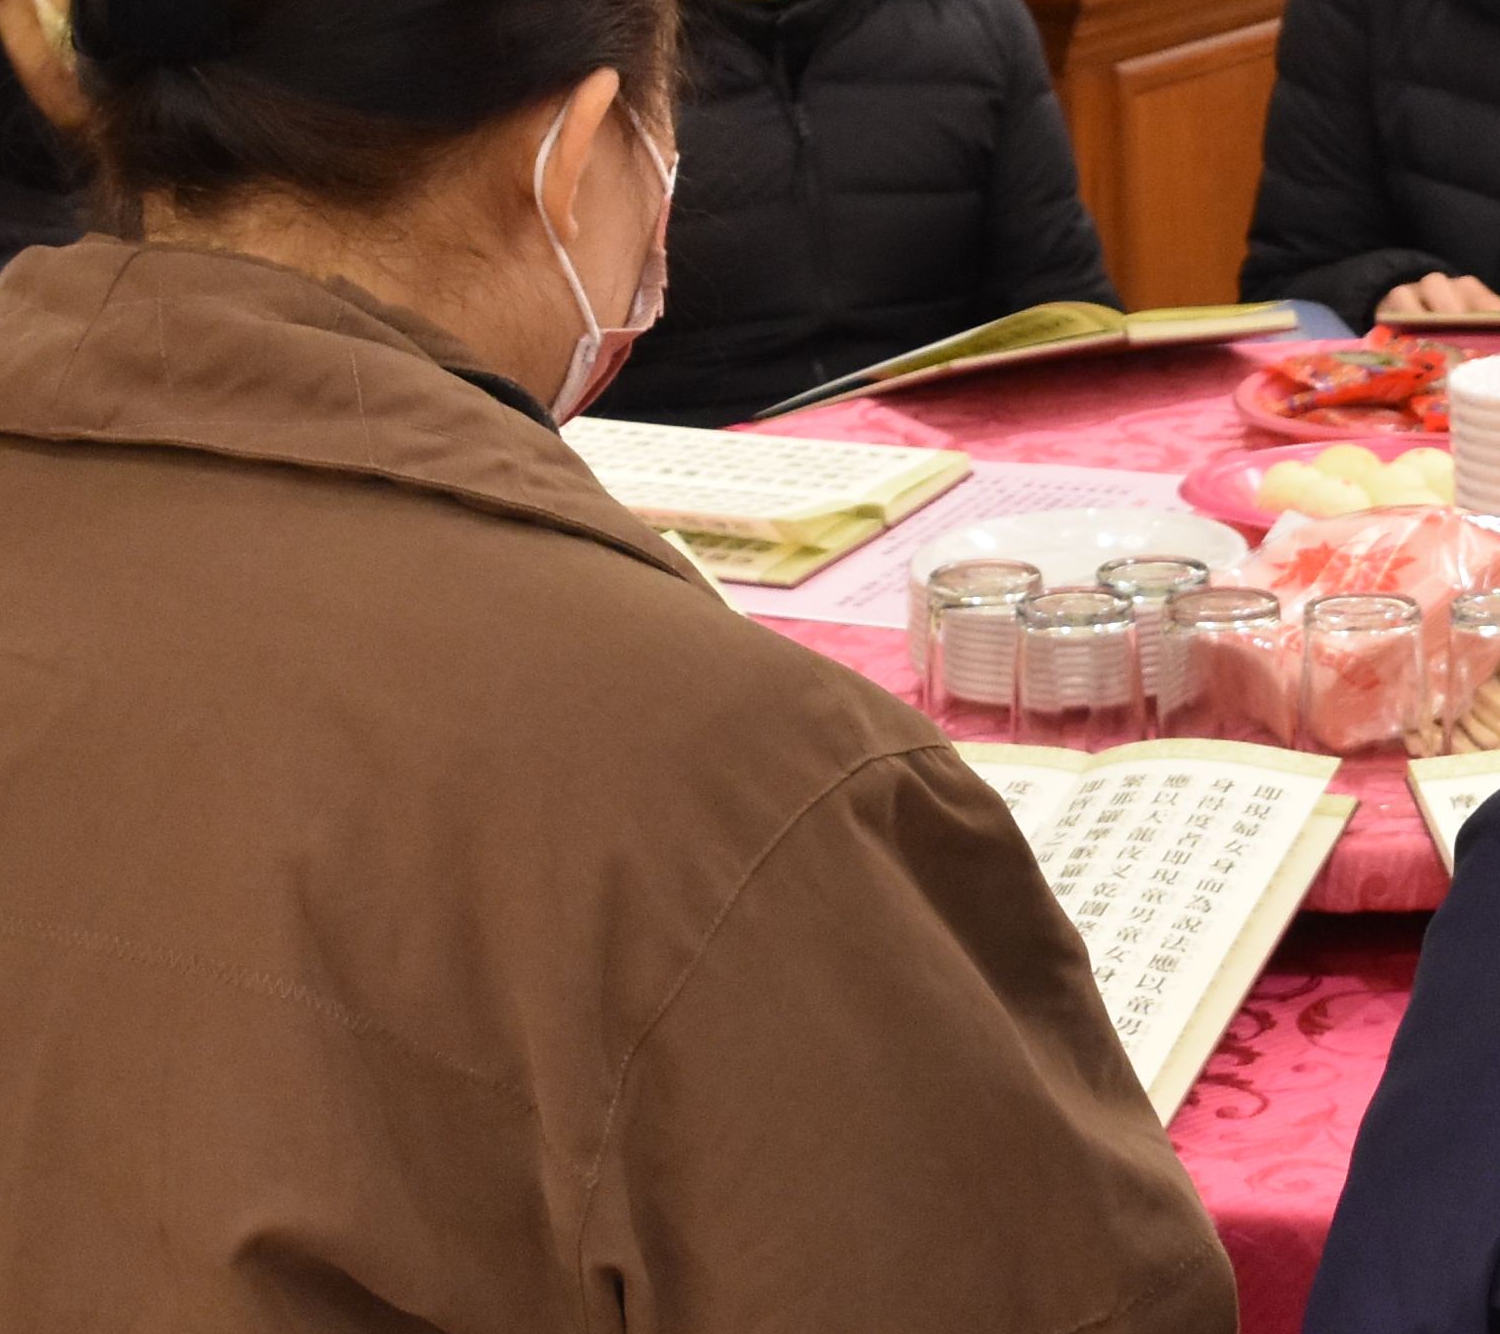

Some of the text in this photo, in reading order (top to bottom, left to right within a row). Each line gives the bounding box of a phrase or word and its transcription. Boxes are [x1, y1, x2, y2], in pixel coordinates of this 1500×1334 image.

[1093, 778, 1234, 995] 身得度者即現童男童女身
[1117, 784, 1283, 1047] 即現婦女身而為說法應以童男
